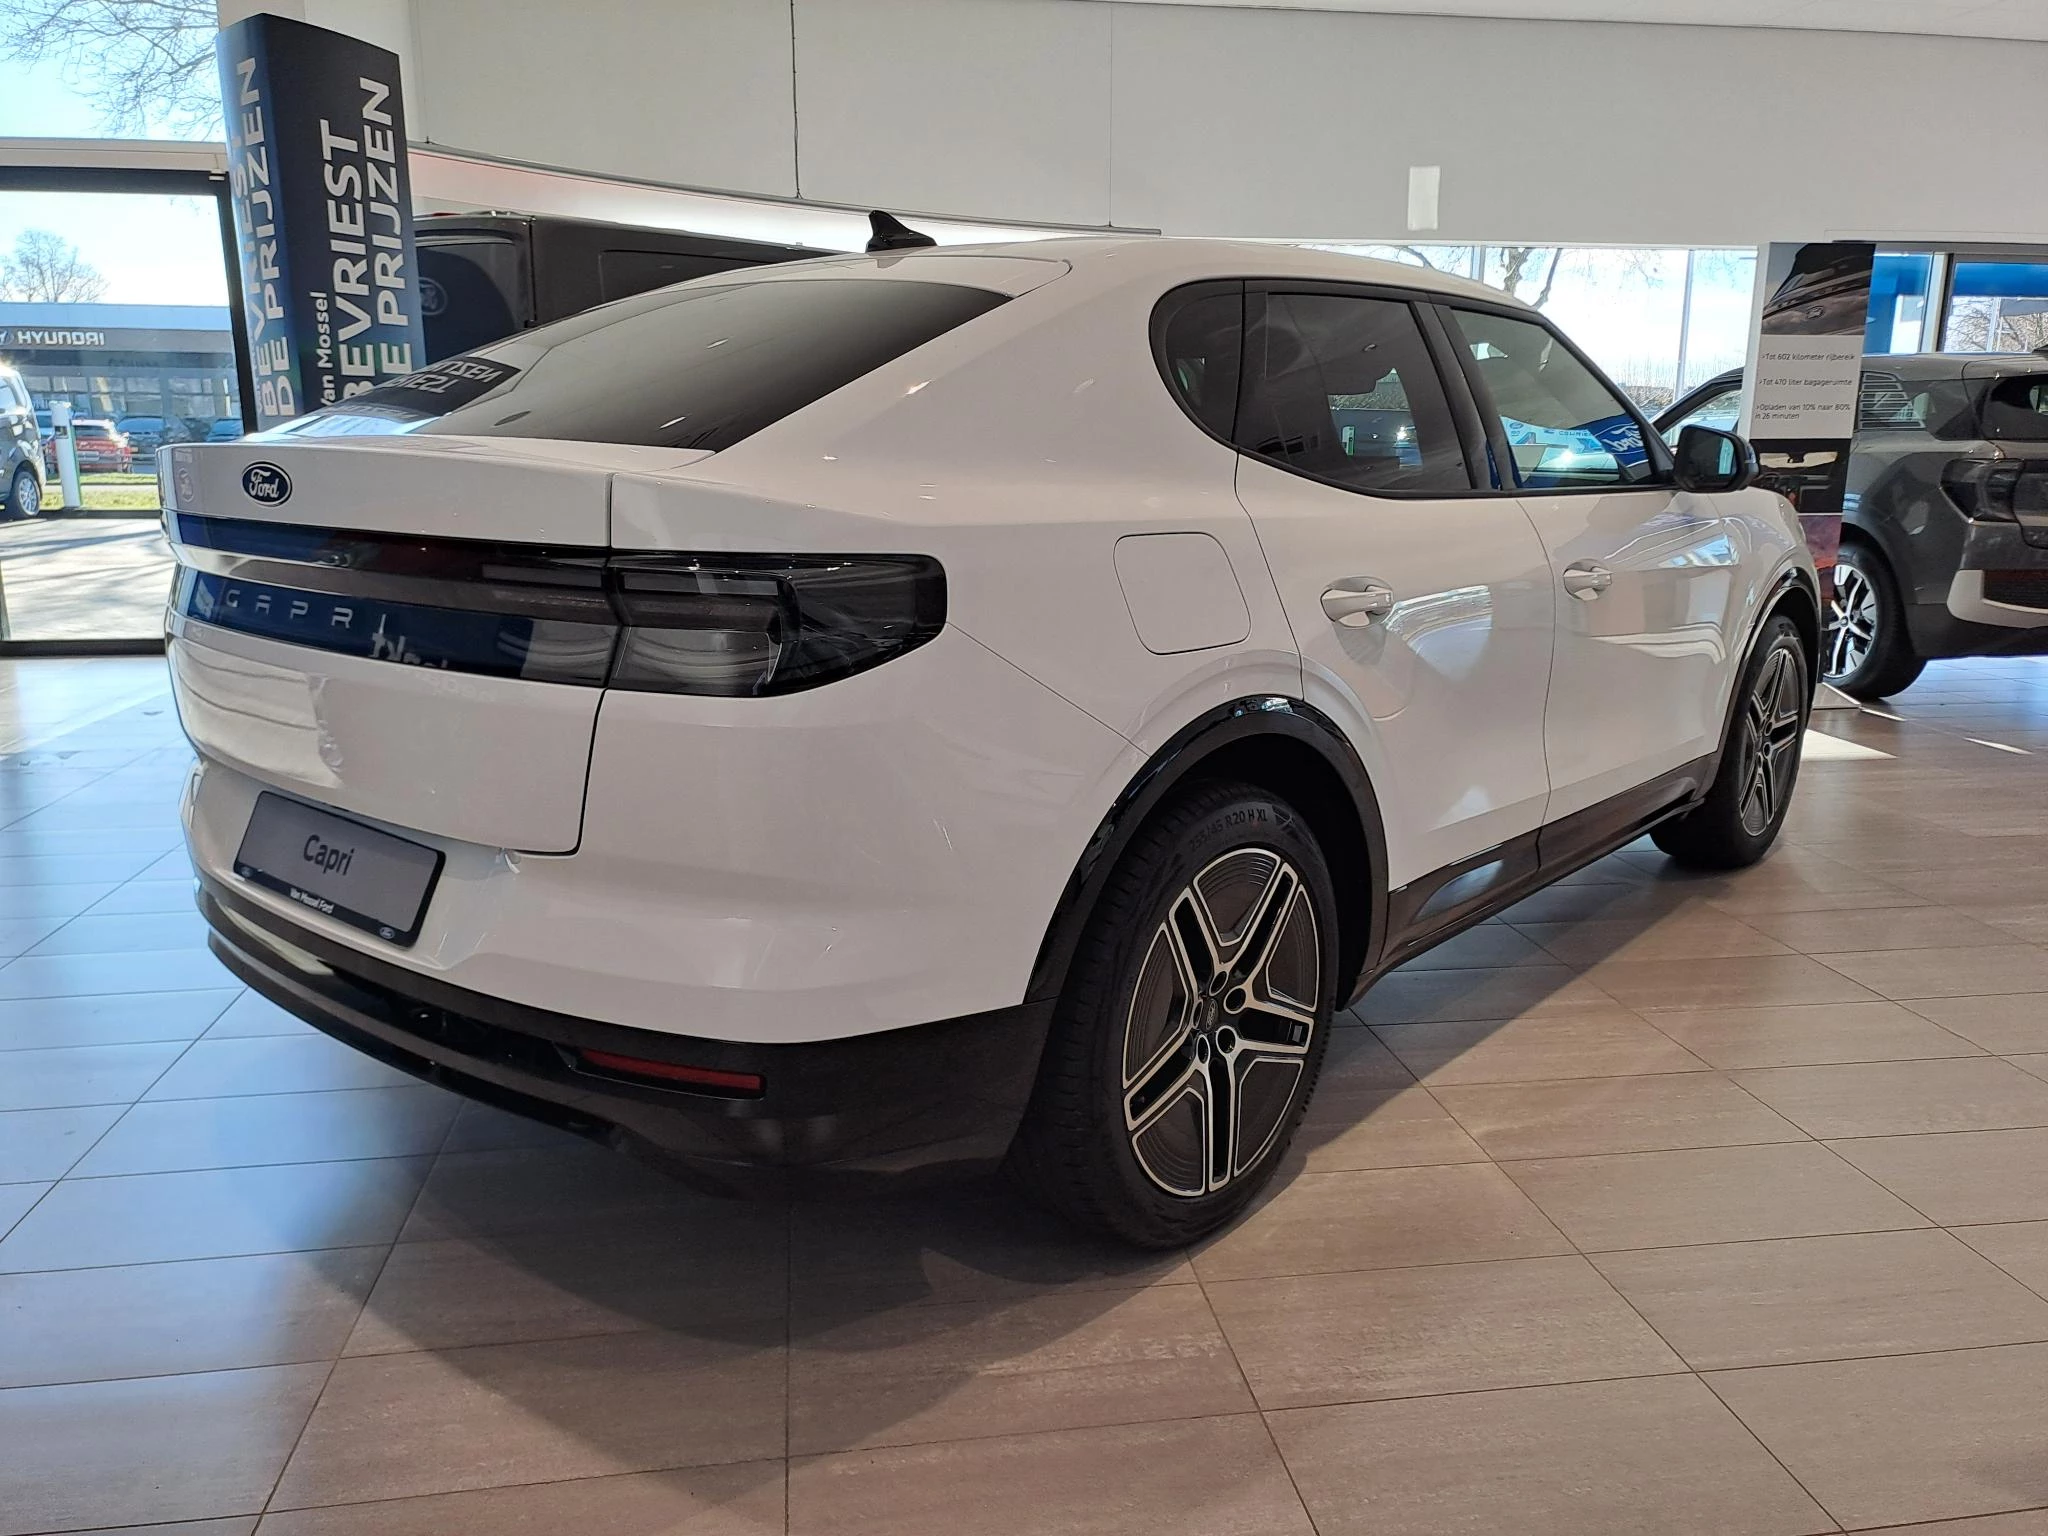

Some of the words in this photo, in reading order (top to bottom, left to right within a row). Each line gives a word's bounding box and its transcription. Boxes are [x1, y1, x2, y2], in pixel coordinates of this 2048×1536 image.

[236, 57, 285, 320] PRIJZEN
[359, 76, 409, 326] PRIJZEN
[17, 330, 105, 346] HYUNDAI
[309, 291, 334, 369] Mossel
[270, 336, 295, 416] DE
[249, 468, 280, 498] Ford
[303, 834, 355, 877] Capri
